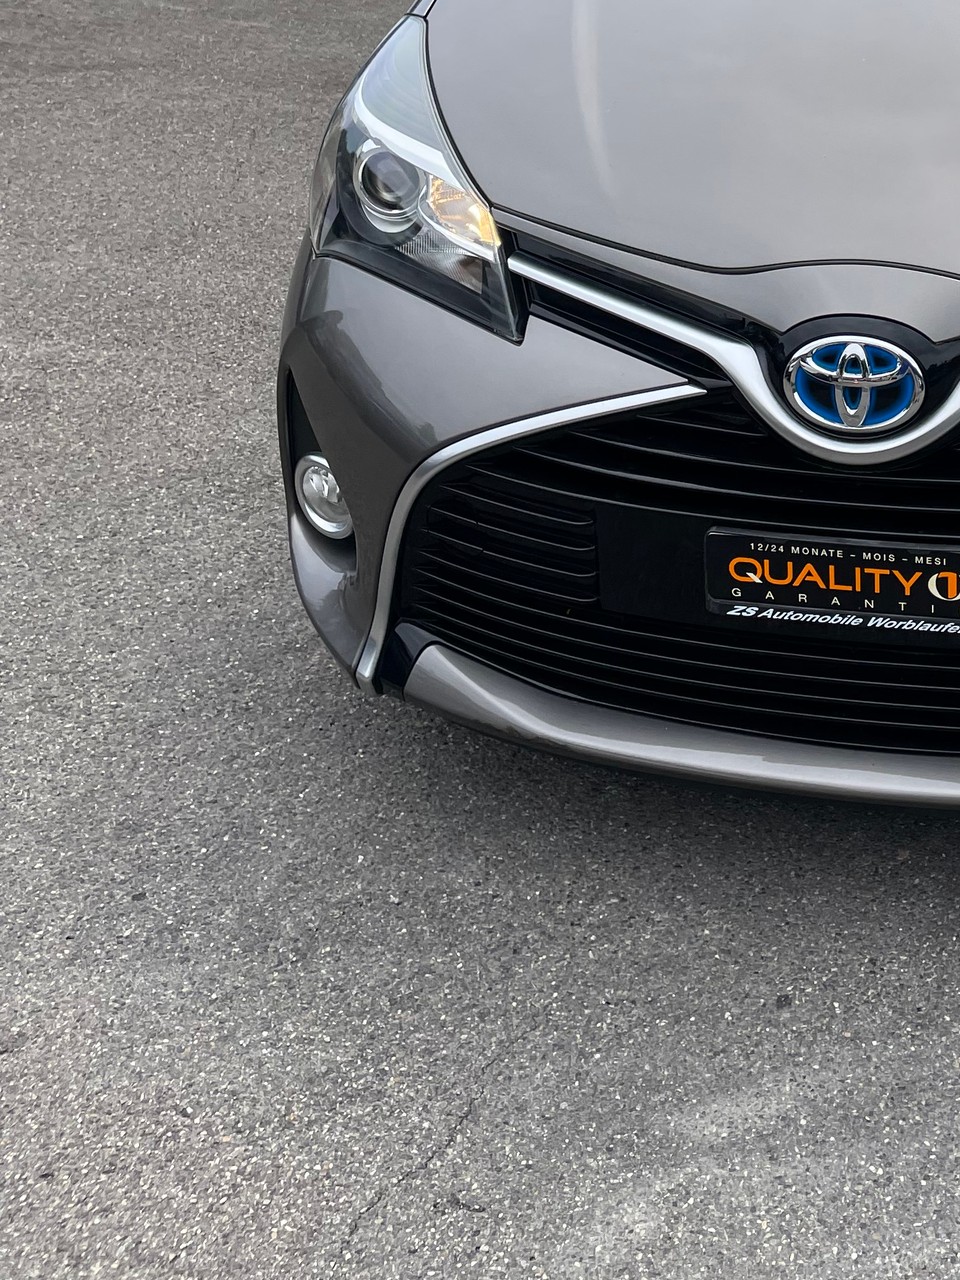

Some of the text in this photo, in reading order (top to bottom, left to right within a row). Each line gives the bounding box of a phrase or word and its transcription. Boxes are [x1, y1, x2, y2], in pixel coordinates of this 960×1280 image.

[750, 542, 785, 553] 12/24
[791, 545, 844, 558] MONATE
[862, 552, 896, 562] MOIS
[915, 556, 947, 566] MESI
[728, 556, 923, 596] QUALITY
[726, 605, 759, 617] ZS
[758, 608, 863, 626] Automobile
